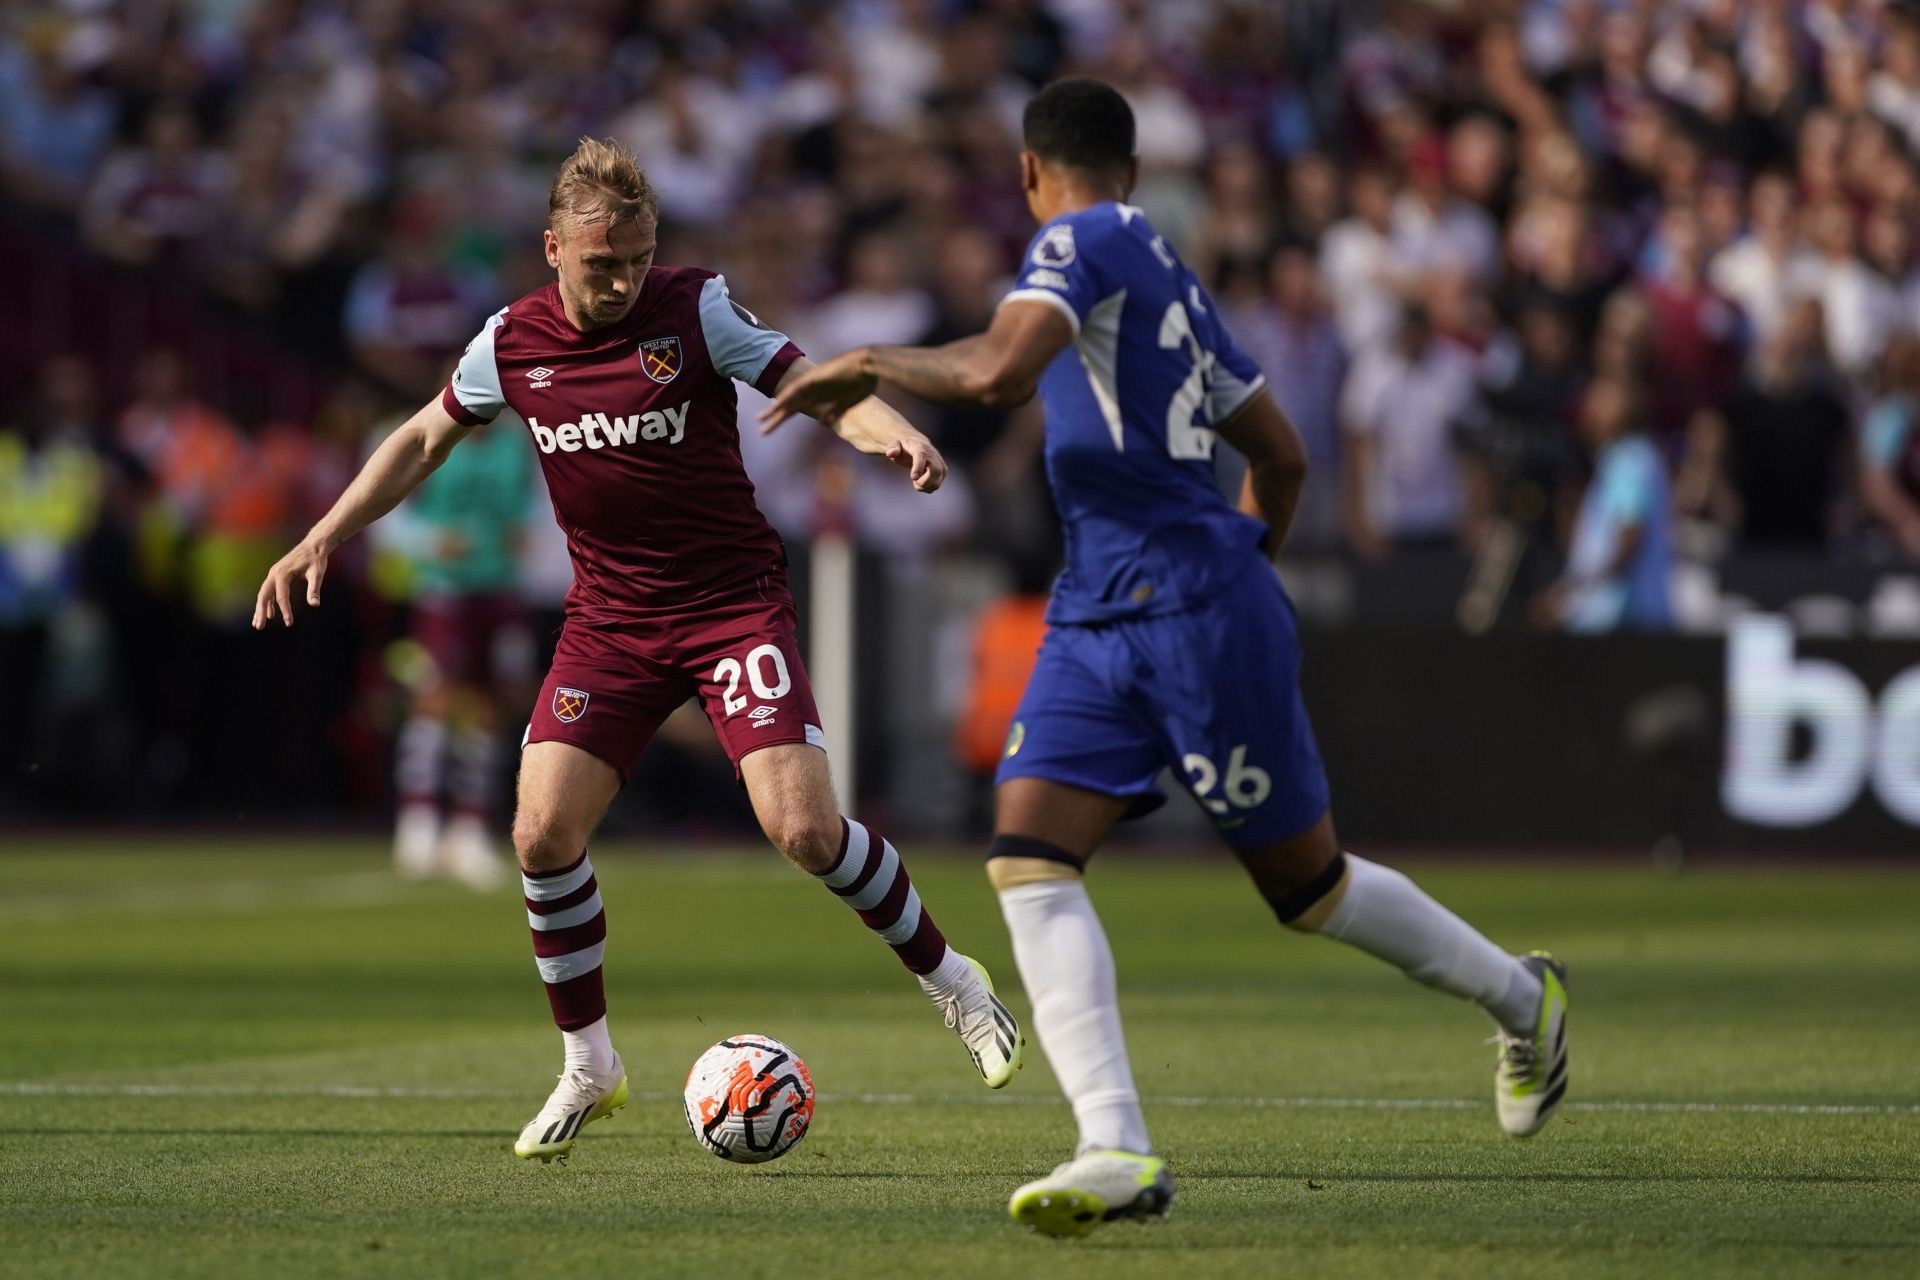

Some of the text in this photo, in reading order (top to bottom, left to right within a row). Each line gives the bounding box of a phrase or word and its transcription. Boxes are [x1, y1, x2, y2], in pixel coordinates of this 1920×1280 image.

[530, 380, 552, 389] umbro
[1158, 300, 1216, 460] 2
[528, 400, 691, 454] betway
[713, 643, 792, 717] 20
[752, 717, 775, 729] umbro
[1182, 744, 1272, 815] 26
